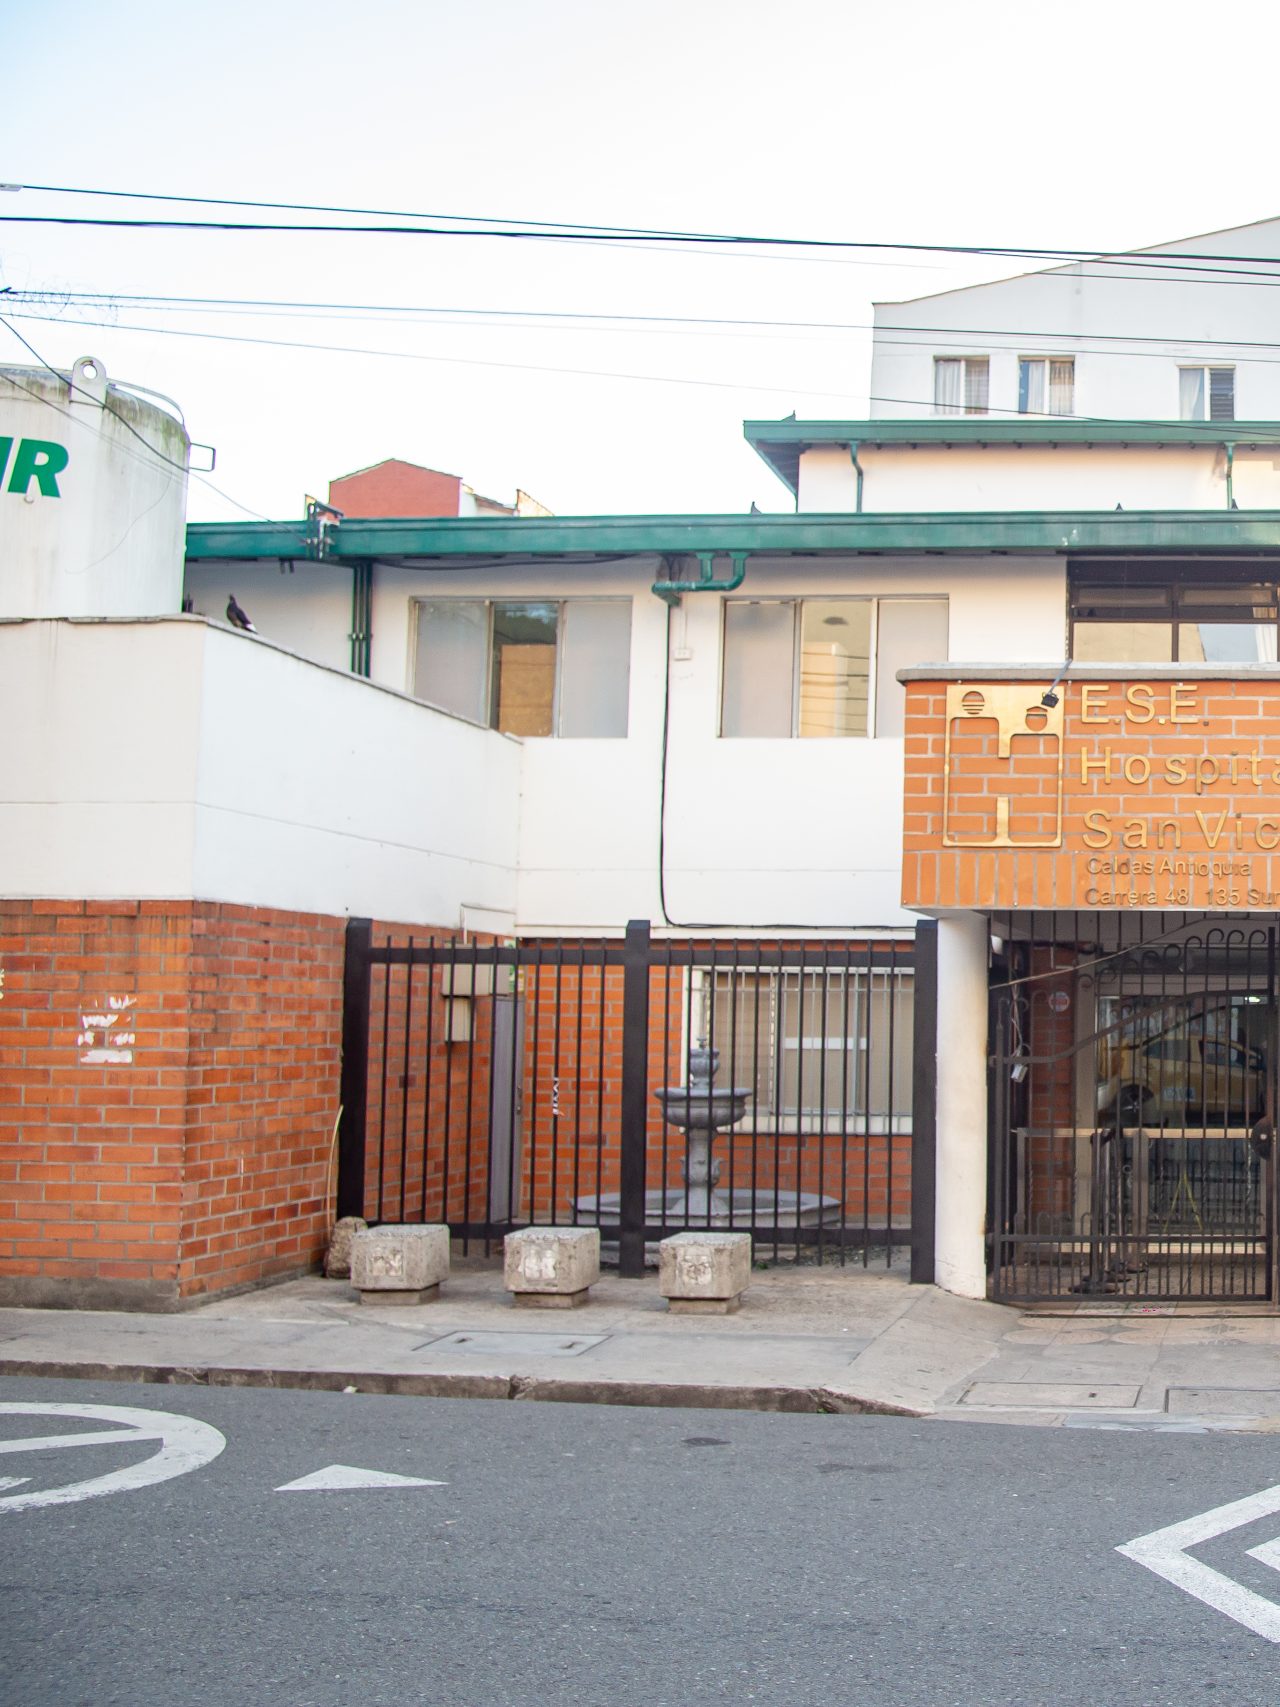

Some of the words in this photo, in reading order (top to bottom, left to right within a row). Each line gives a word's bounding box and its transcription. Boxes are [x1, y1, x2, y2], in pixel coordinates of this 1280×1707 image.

[1081, 684, 1210, 727] E.S.E.
[1083, 808, 1182, 849] San
[1087, 856, 1154, 875] Caldas
[1159, 856, 1252, 879] Antioquia
[1085, 887, 1157, 906] Carrera
[1164, 887, 1190, 905] 48
[1205, 887, 1241, 906] 135
[1247, 887, 1280, 906] Sur
